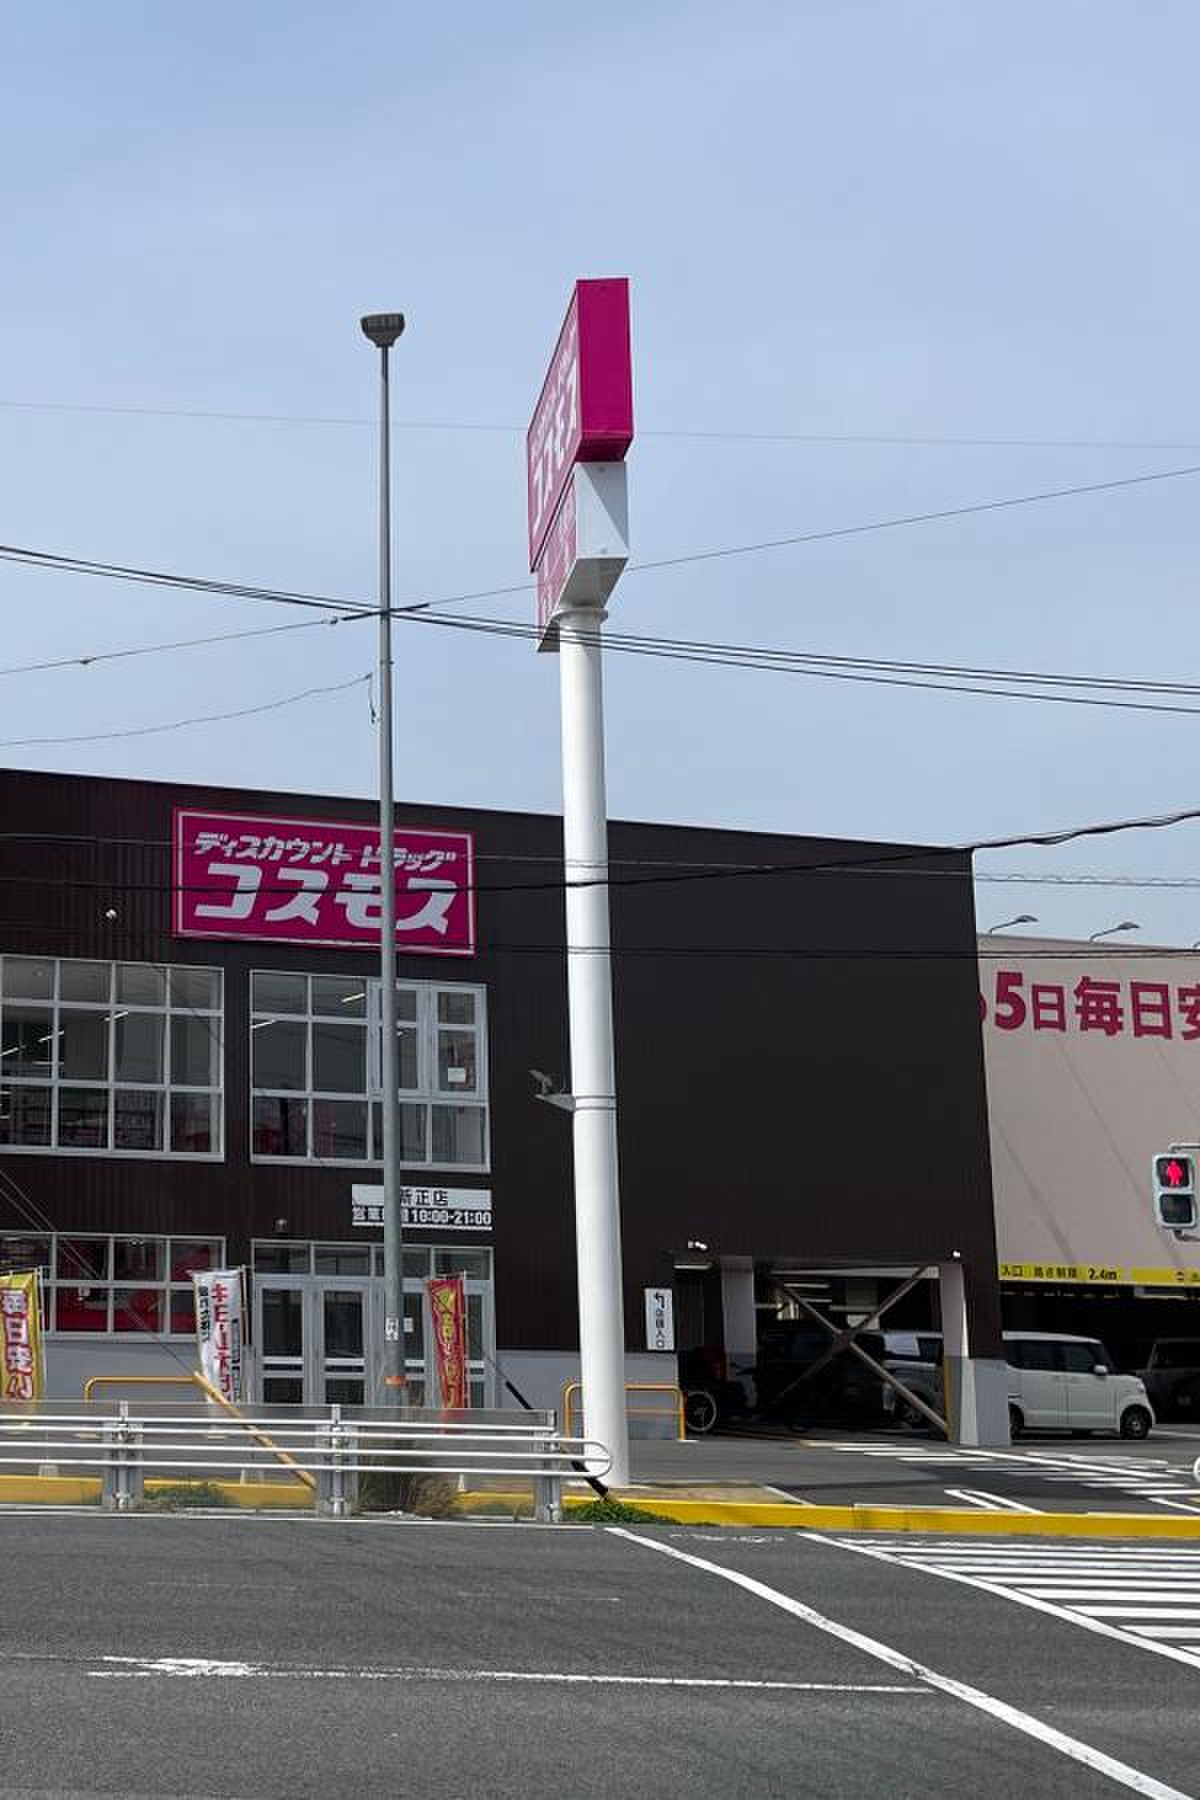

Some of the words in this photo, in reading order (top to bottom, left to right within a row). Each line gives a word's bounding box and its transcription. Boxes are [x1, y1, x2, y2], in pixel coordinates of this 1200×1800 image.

[194, 832, 352, 865] ディスカウント
[194, 862, 458, 935] コスモス
